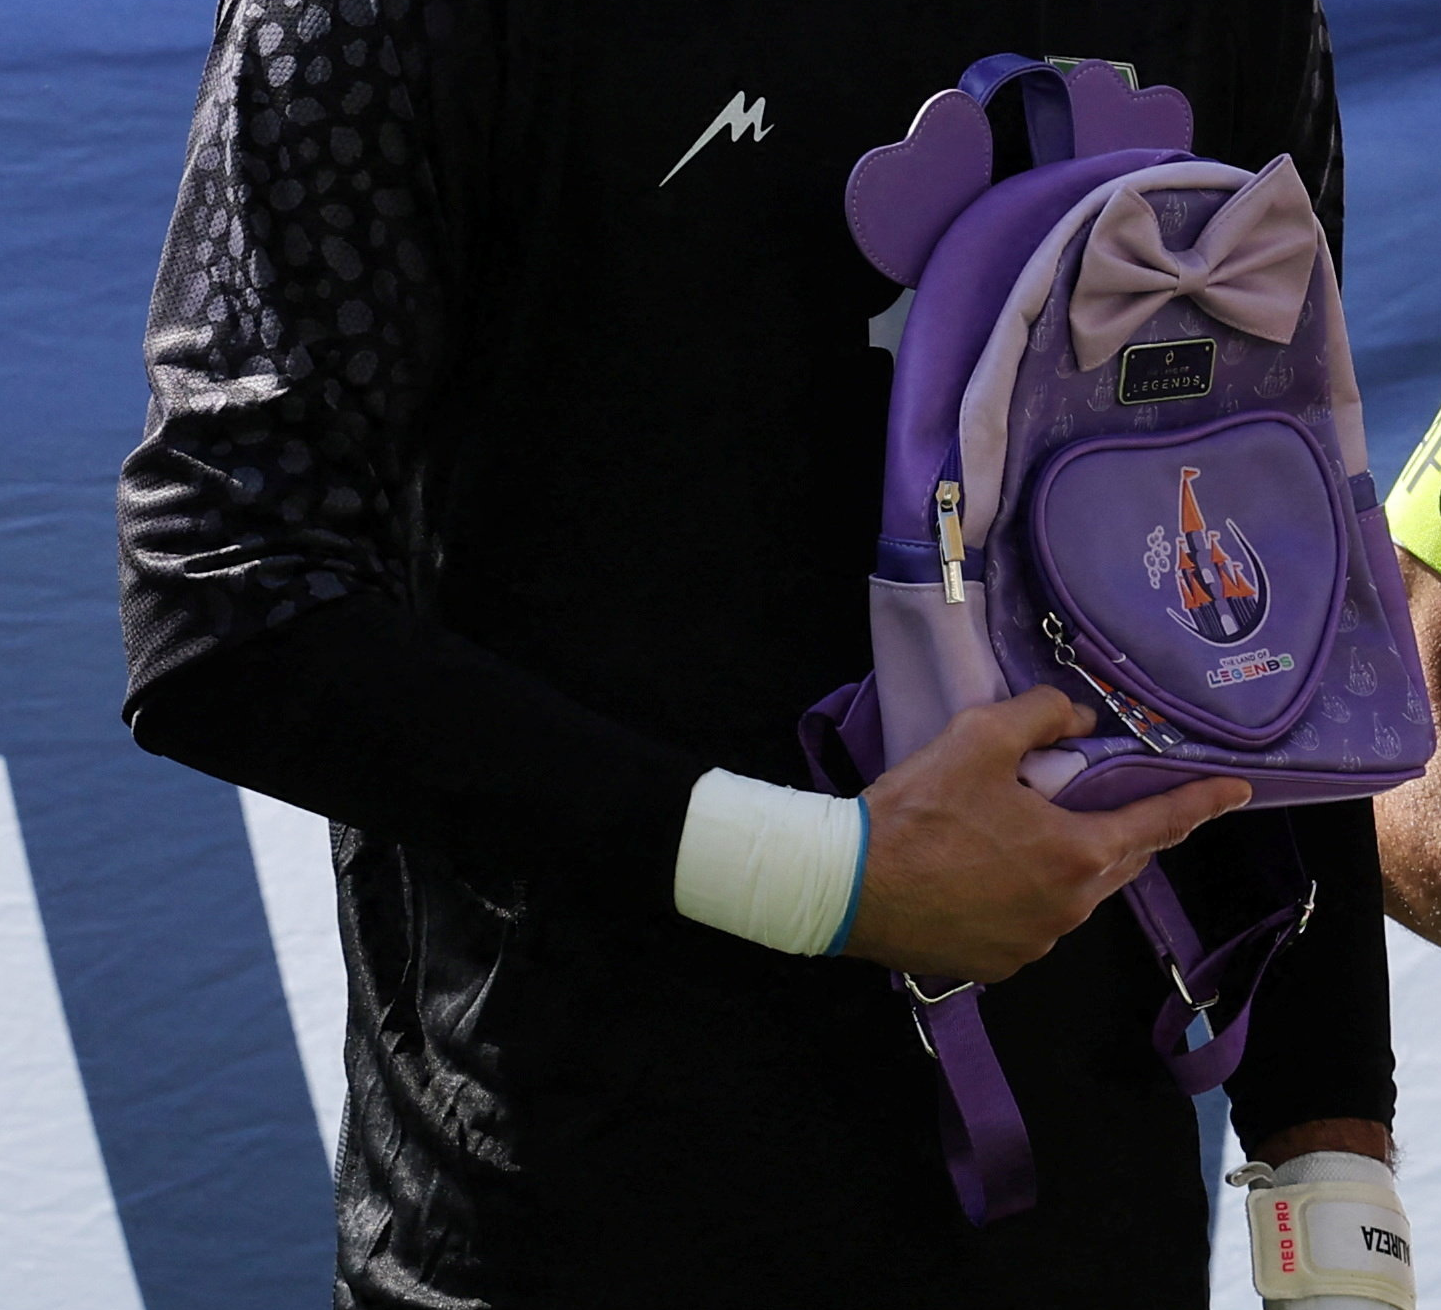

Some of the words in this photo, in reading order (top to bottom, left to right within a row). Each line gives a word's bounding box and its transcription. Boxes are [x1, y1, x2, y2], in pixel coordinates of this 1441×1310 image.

[1208, 655, 1293, 685] LEGENDS
[1238, 654, 1256, 664] LAND
[1257, 650, 1267, 659] OF
[1275, 1201, 1292, 1232] PRO
